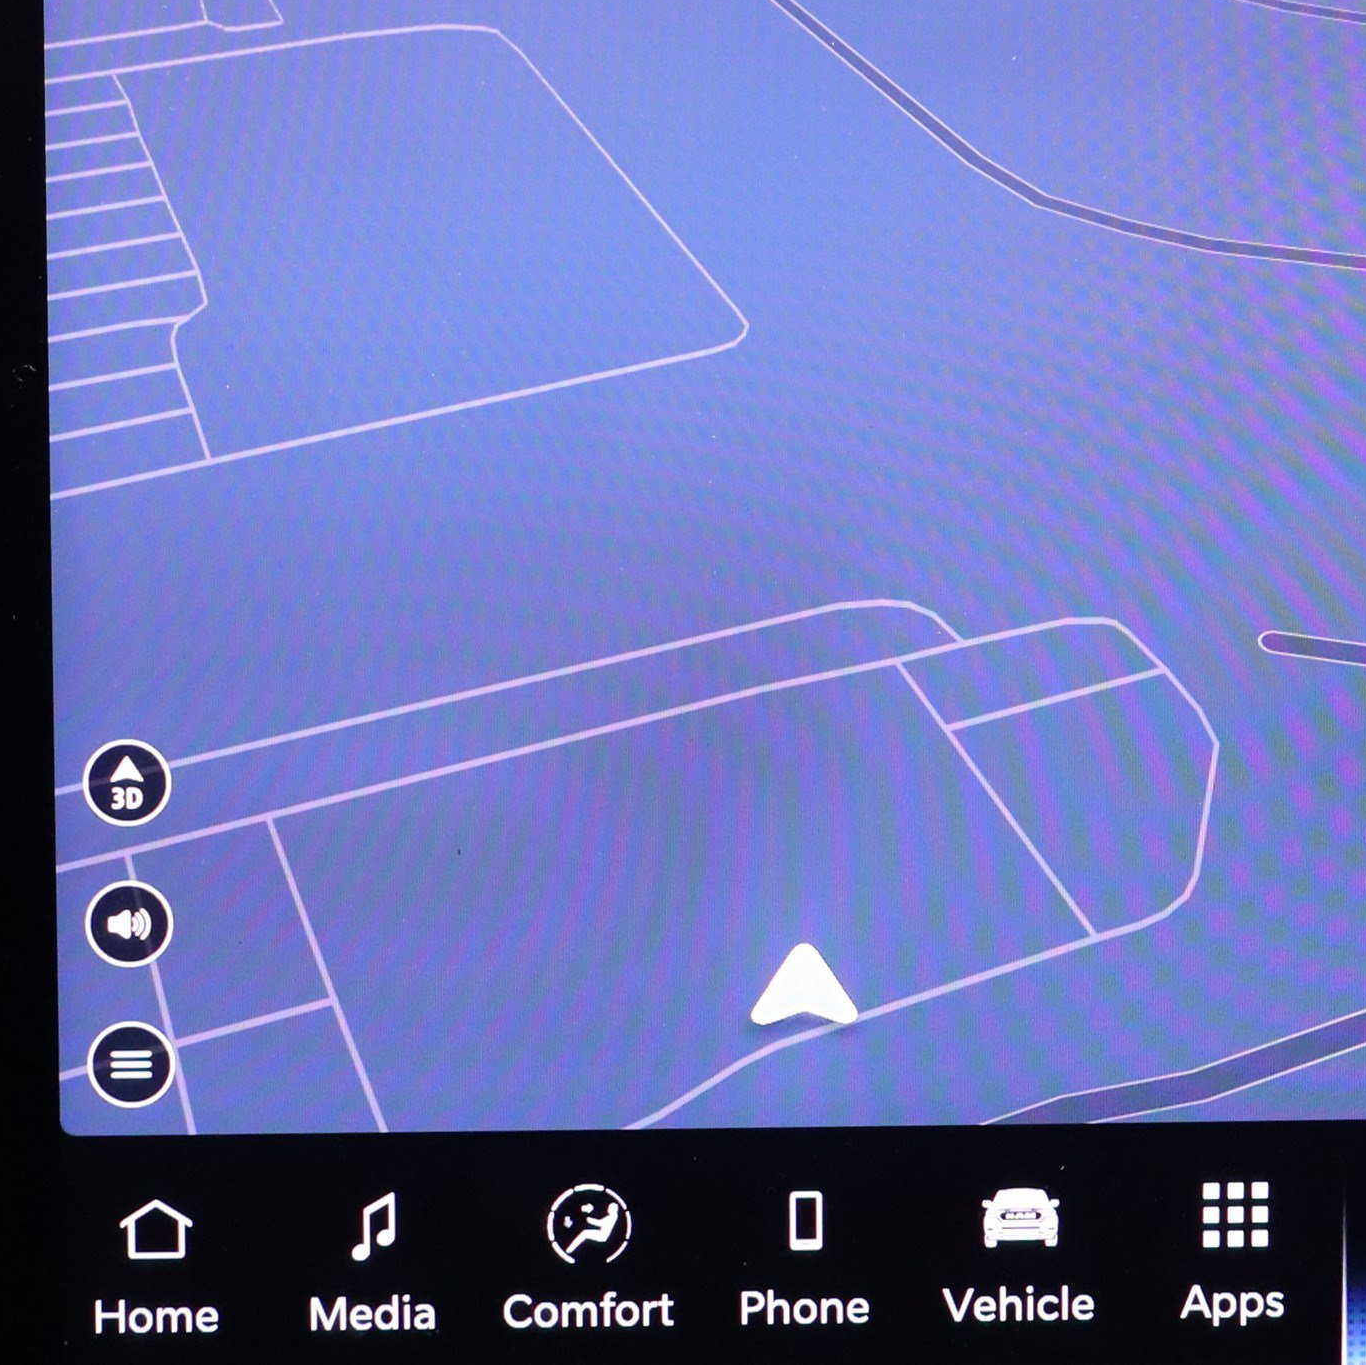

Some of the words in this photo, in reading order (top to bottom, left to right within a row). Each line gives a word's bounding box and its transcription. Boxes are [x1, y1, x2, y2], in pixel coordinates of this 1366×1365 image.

[110, 787, 143, 810] 3D
[94, 1300, 220, 1334] Home
[310, 1296, 436, 1331] Media
[502, 1293, 674, 1329] Comfort
[739, 1290, 869, 1326] Phone
[943, 1286, 1095, 1322] Vehicle
[1180, 1285, 1284, 1327] Apps
